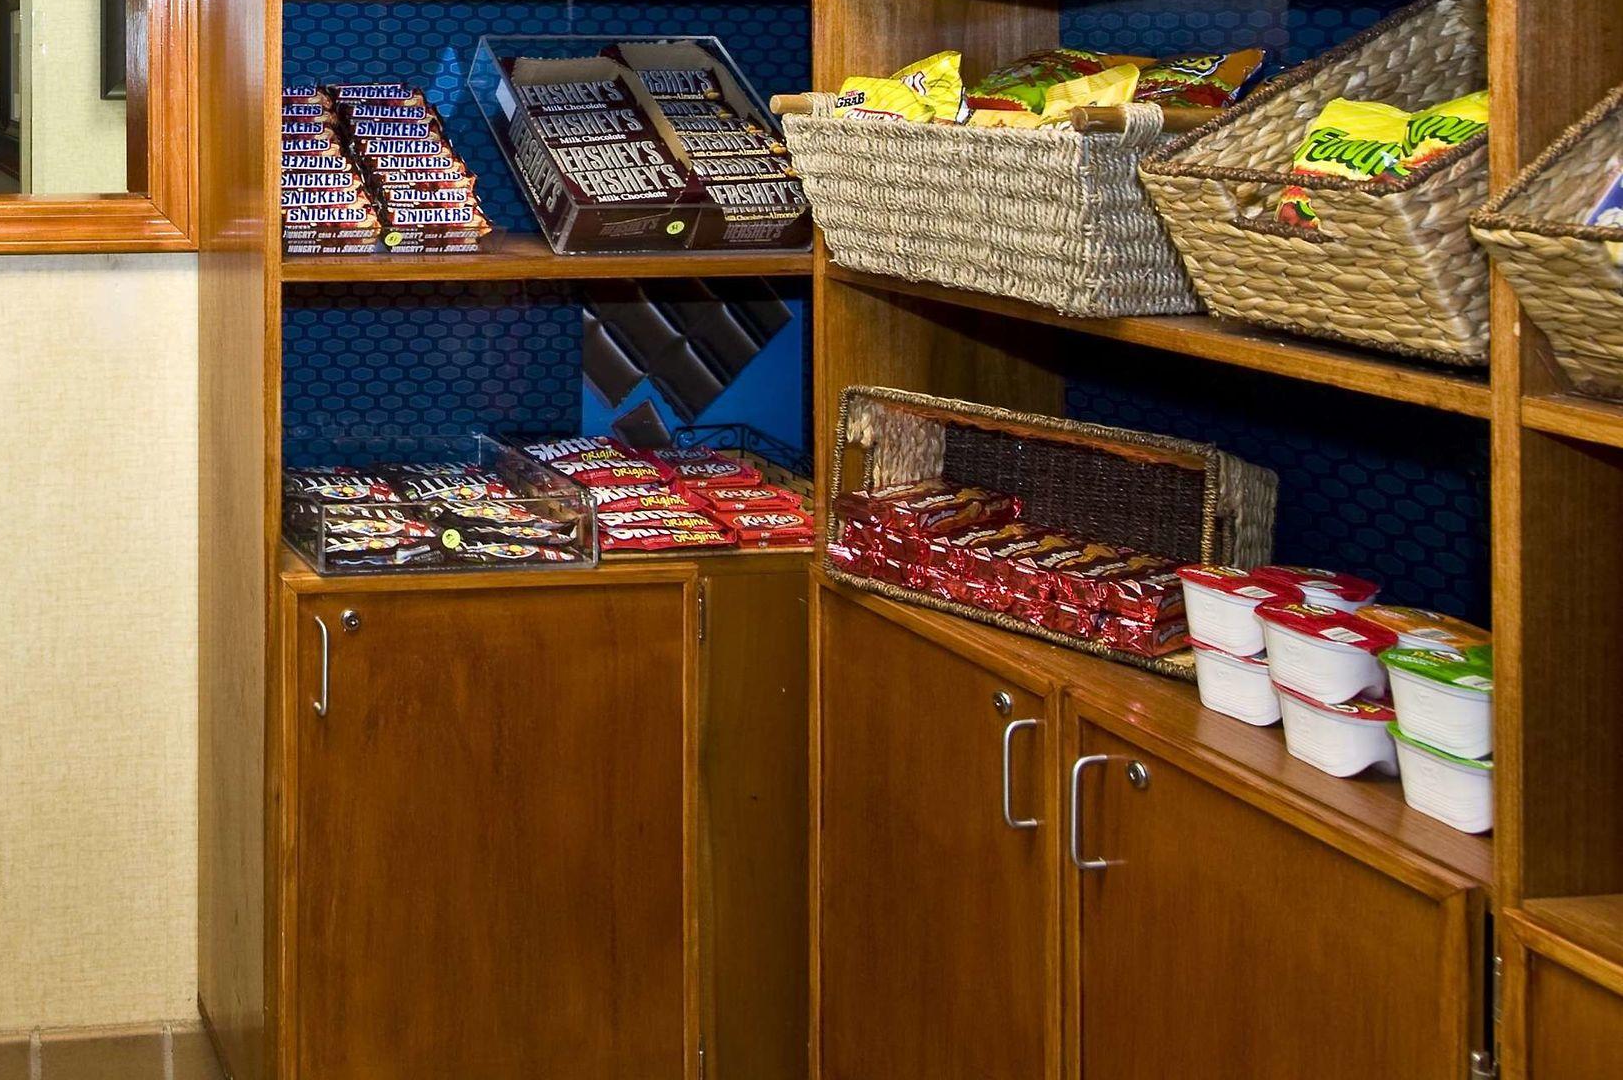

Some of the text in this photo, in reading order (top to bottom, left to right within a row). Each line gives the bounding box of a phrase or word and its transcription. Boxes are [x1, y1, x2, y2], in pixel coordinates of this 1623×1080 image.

[341, 85, 411, 98] SNICKERS
[676, 92, 704, 100] Almonds
[835, 92, 865, 108] GRAB
[356, 105, 425, 118] SNICKERS
[542, 102, 607, 112] Milk Chocolate
[357, 122, 427, 136] SNICKERS
[559, 132, 627, 144] Milk Chocolate
[369, 140, 440, 153] SNICKERS
[739, 148, 770, 156] Almonds
[380, 156, 451, 168] SNICKERS
[282, 174, 351, 186] SNICKERS
[755, 171, 786, 179] Almonds
[282, 191, 355, 204] SNICKERS
[393, 189, 465, 201] SNICKERS
[597, 189, 668, 203] Milk Chocolate
[290, 208, 365, 221] SNICKERS
[397, 208, 471, 223] SNICKERS
[769, 210, 800, 219] Almonds
